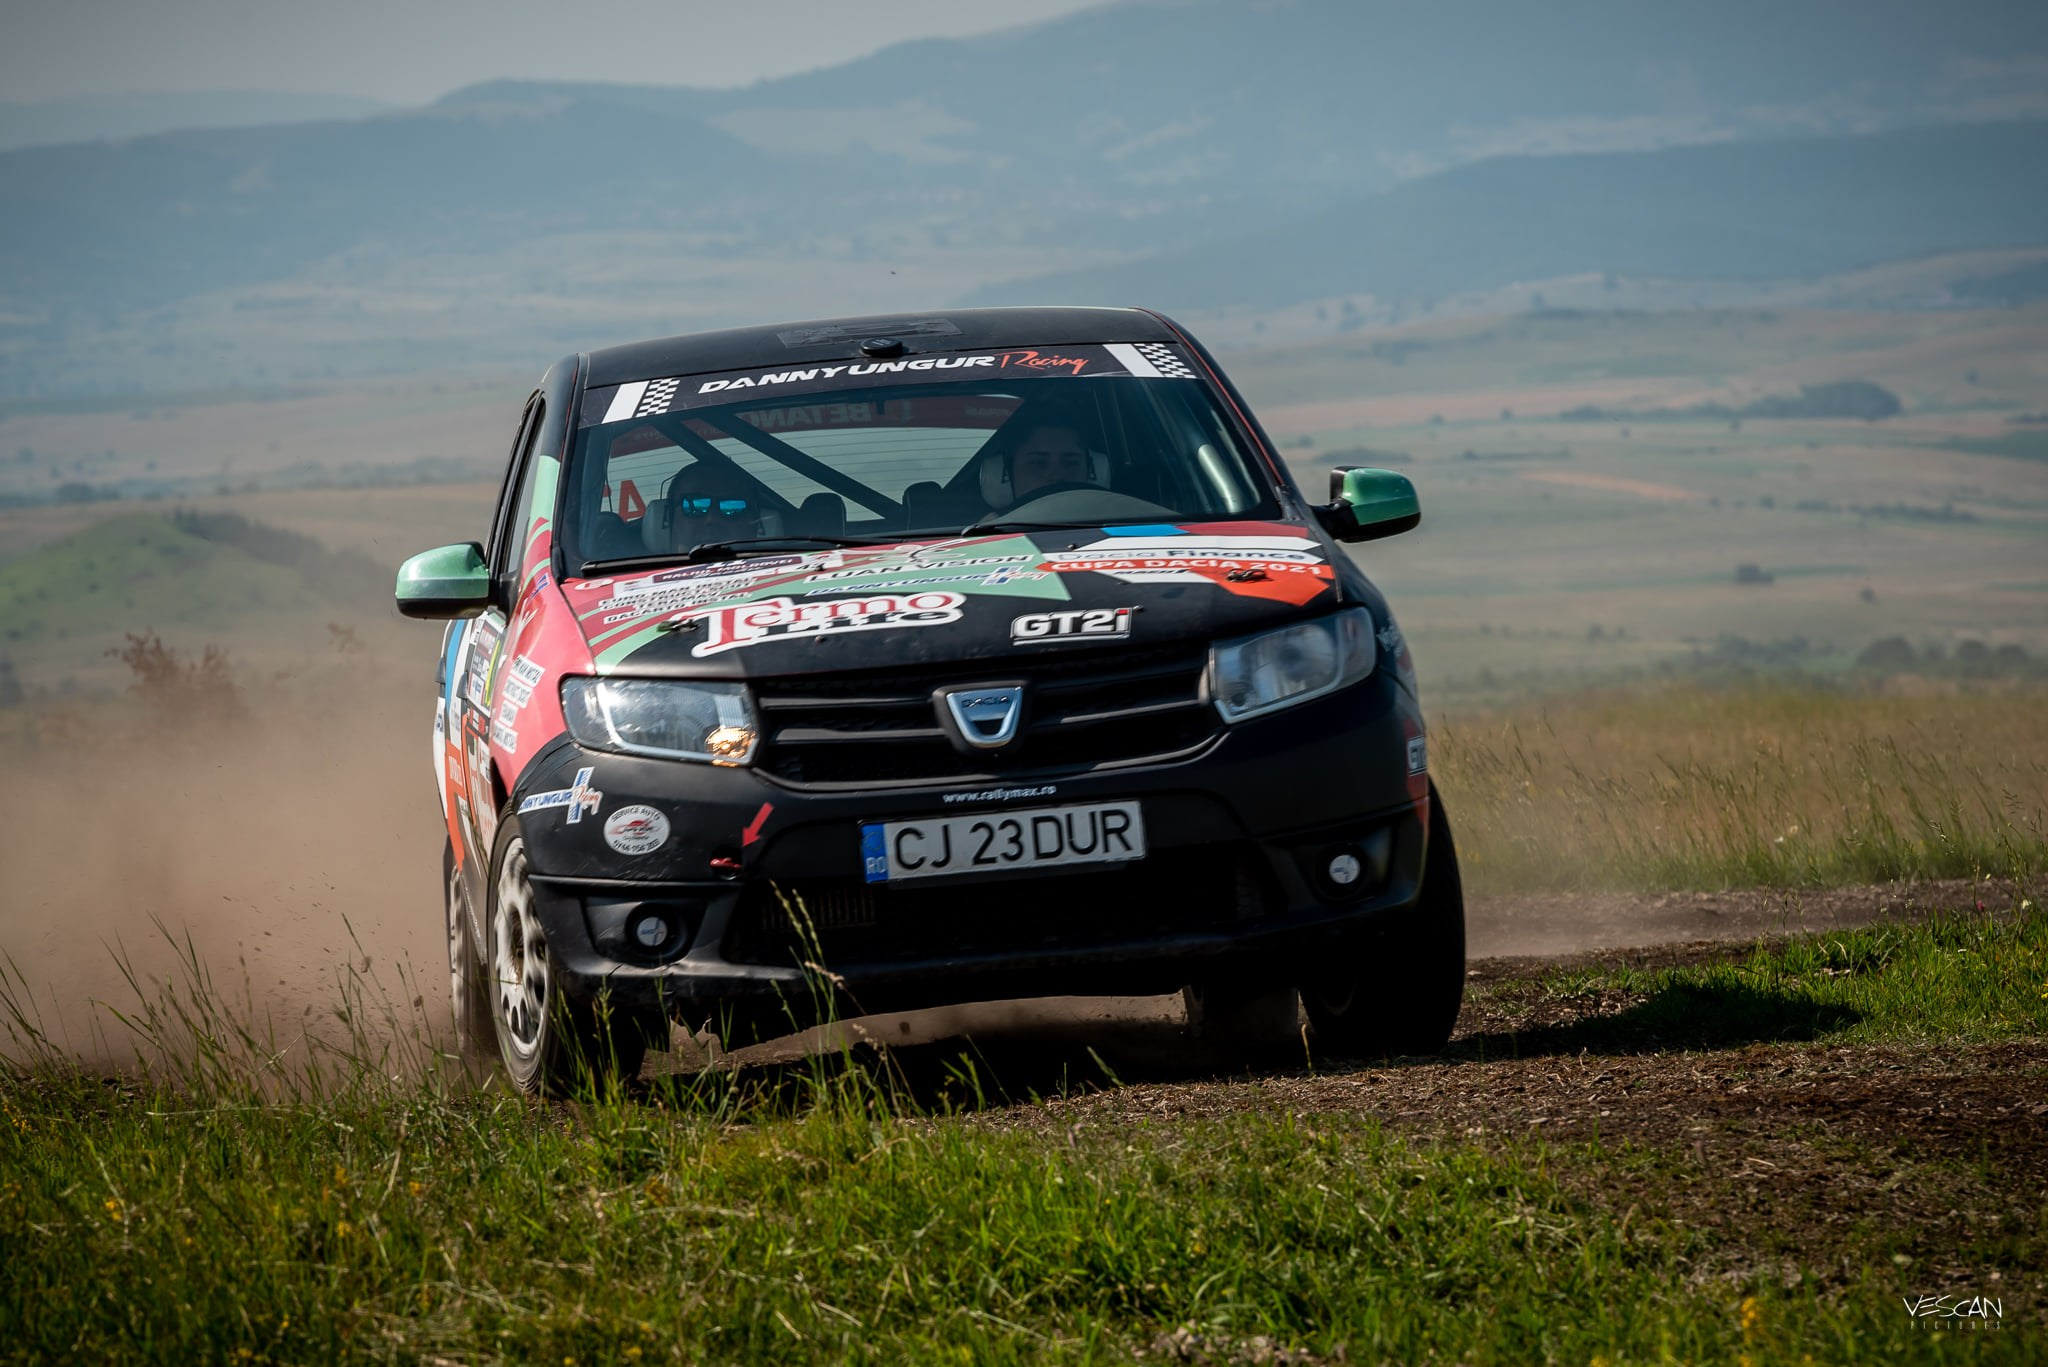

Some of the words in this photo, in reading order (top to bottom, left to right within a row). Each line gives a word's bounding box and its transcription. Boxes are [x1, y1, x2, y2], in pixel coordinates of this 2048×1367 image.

[994, 351, 1089, 375] Racing
[1051, 560, 1137, 571] CUPA
[1143, 559, 1242, 570] DACIA
[1250, 562, 1322, 575] 2021
[1057, 550, 1155, 560] Dacia
[1167, 550, 1306, 560] Finance
[809, 565, 903, 582] LUAN
[916, 555, 1029, 569] VISION
[1013, 608, 1130, 638] GT2i
[942, 785, 1057, 803] www.rallymax.ro
[894, 824, 951, 870] CJ
